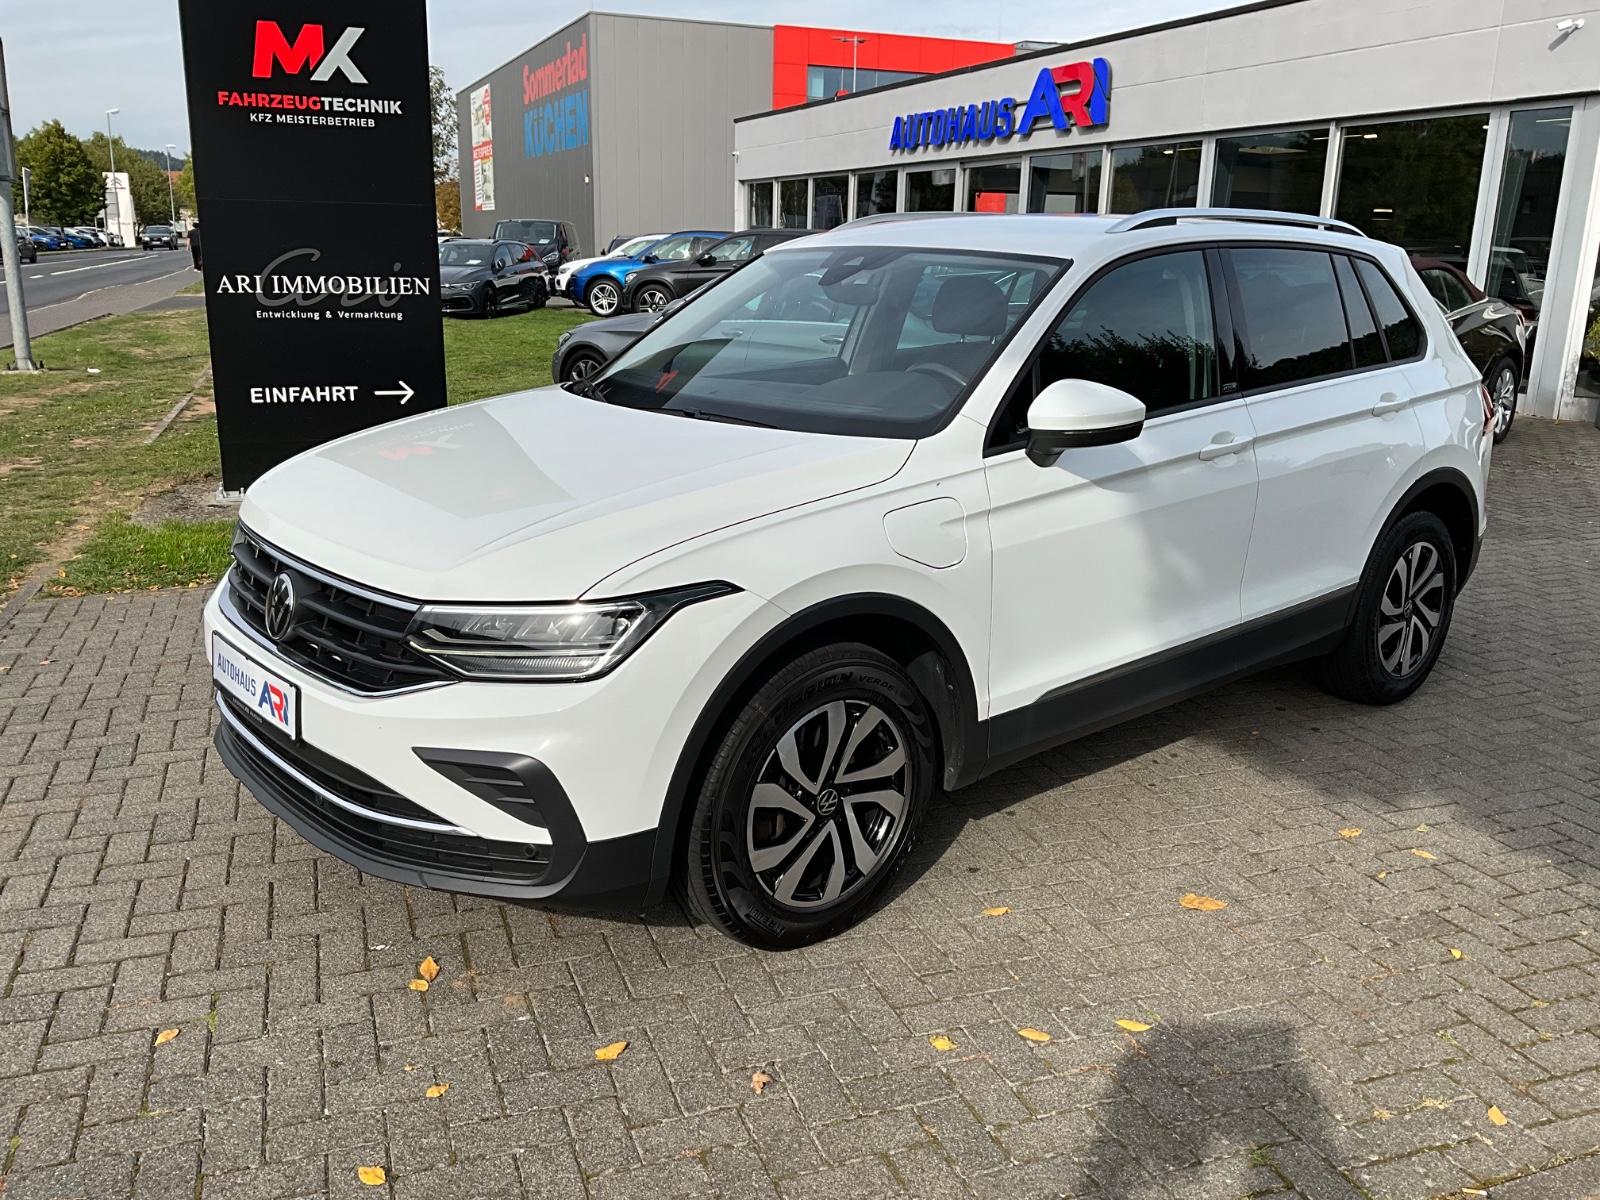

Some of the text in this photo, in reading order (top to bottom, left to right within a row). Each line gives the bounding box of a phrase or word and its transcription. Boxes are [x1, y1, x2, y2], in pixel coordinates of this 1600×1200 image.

[252, 20, 368, 84] MK
[523, 32, 587, 105] Sommerlad
[217, 91, 402, 114] FAHRZEUGTECHNIK
[250, 112, 376, 128] KFZ MEISTERBETRIEB
[889, 57, 1111, 151] AUTOHAUS ARI
[524, 89, 588, 160] KÜCHEN
[216, 274, 431, 296] ARI IMMOBILIEN
[256, 310, 403, 321] Entwicklung & Vermarktung
[250, 385, 359, 404] EINFAHRT
[217, 653, 257, 697] AUTOHAUS
[258, 680, 289, 726] ARI
